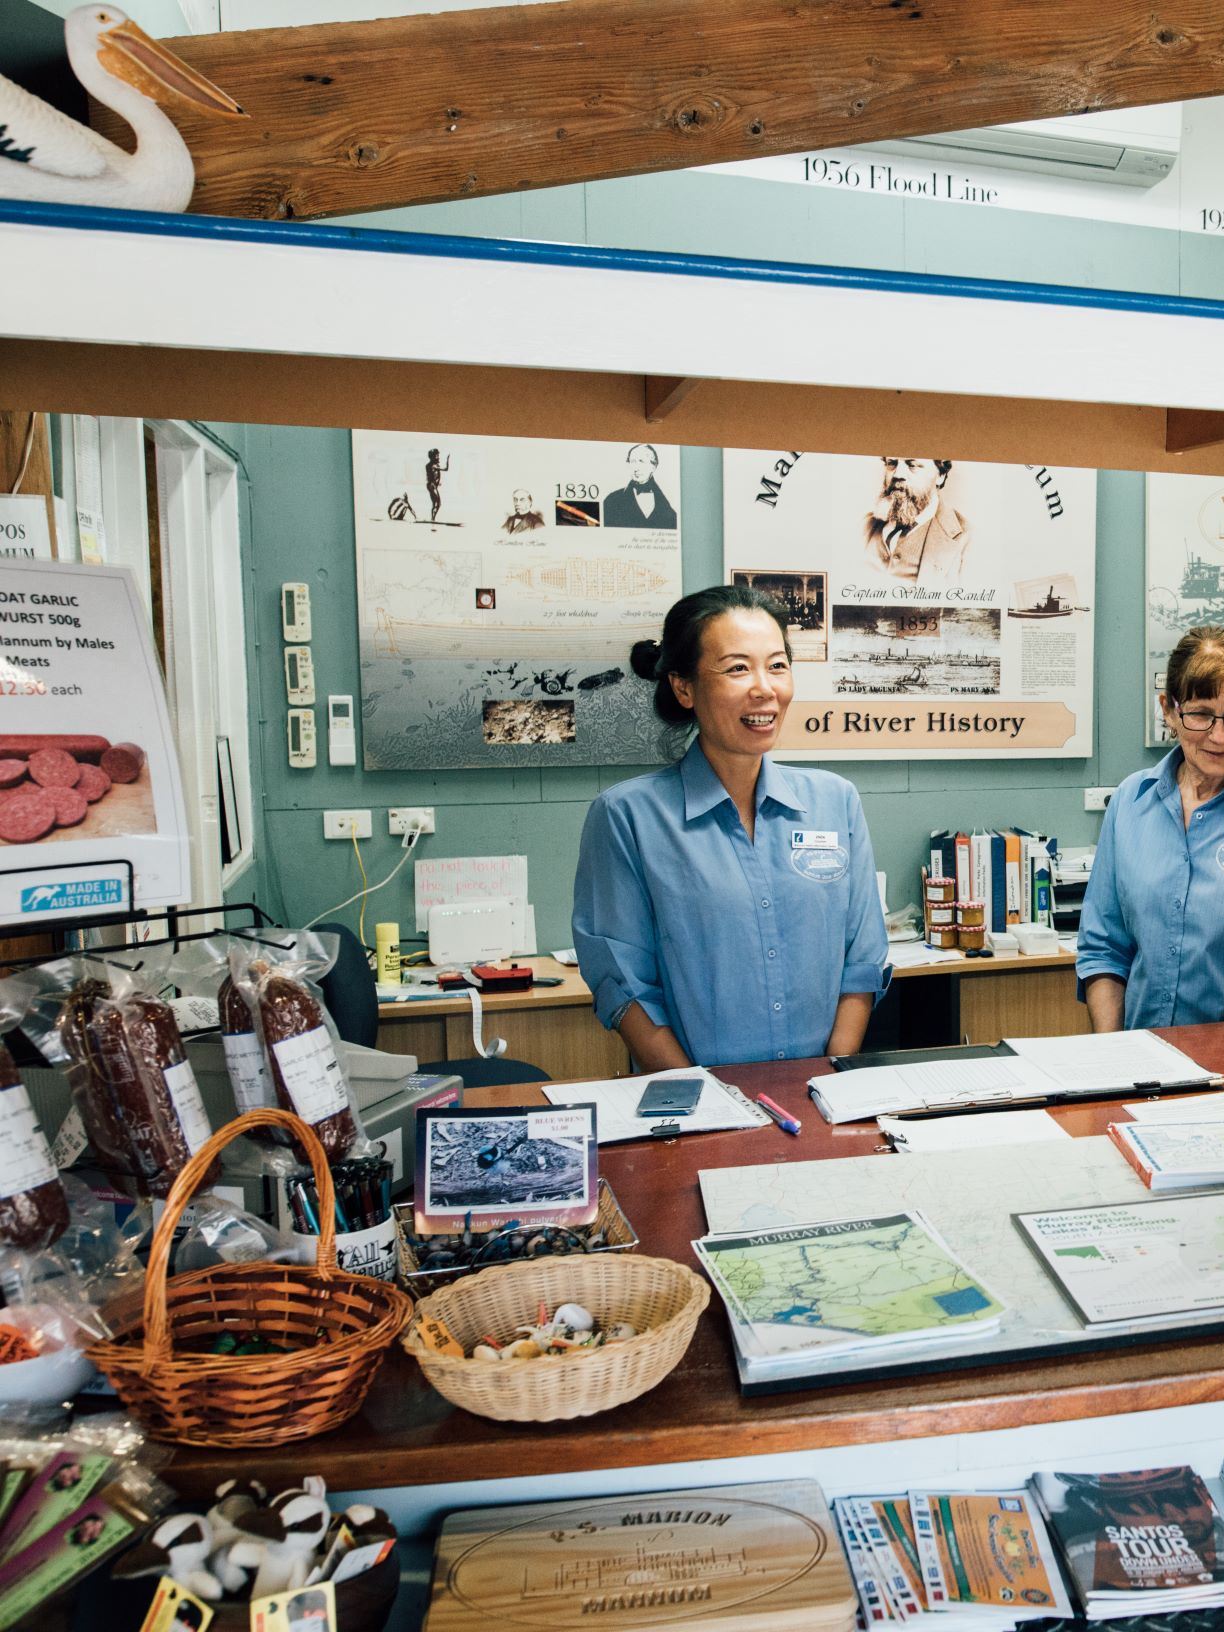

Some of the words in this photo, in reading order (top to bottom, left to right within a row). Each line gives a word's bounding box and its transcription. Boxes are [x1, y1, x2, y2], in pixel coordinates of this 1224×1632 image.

[802, 155, 860, 187] 1956
[868, 164, 938, 198] Flood
[946, 174, 999, 205] Line
[555, 483, 600, 500] 1830
[30, 594, 79, 608] GARLIC
[841, 584, 887, 602] Captain
[892, 585, 942, 601] William
[946, 587, 997, 602] Randell
[48, 613, 81, 629] 500g
[899, 615, 939, 632] 1853
[0, 637, 53, 648] annum
[56, 638, 73, 652] by
[75, 639, 115, 651] Males
[6, 655, 51, 668] Meats
[51, 684, 82, 697] each
[804, 710, 833, 734] of
[844, 711, 916, 734] River
[927, 711, 1026, 738] History
[65, 881, 100, 895] MADE
[105, 880, 118, 891] IN
[50, 891, 119, 908] AUSTRALIA
[1033, 1214, 1108, 1223] Welcome
[1036, 1220, 1092, 1229] Murray
[749, 1228, 821, 1247] MURRAY
[822, 1219, 876, 1236] RIVER
[1041, 1227, 1087, 1235] Lakes
[618, 1509, 732, 1528] MARION
[1104, 1524, 1184, 1540] SANTOS
[1109, 1538, 1196, 1559] TOUR
[1119, 1557, 1159, 1568] DOWN
[580, 1582, 713, 1615] MANNUM
